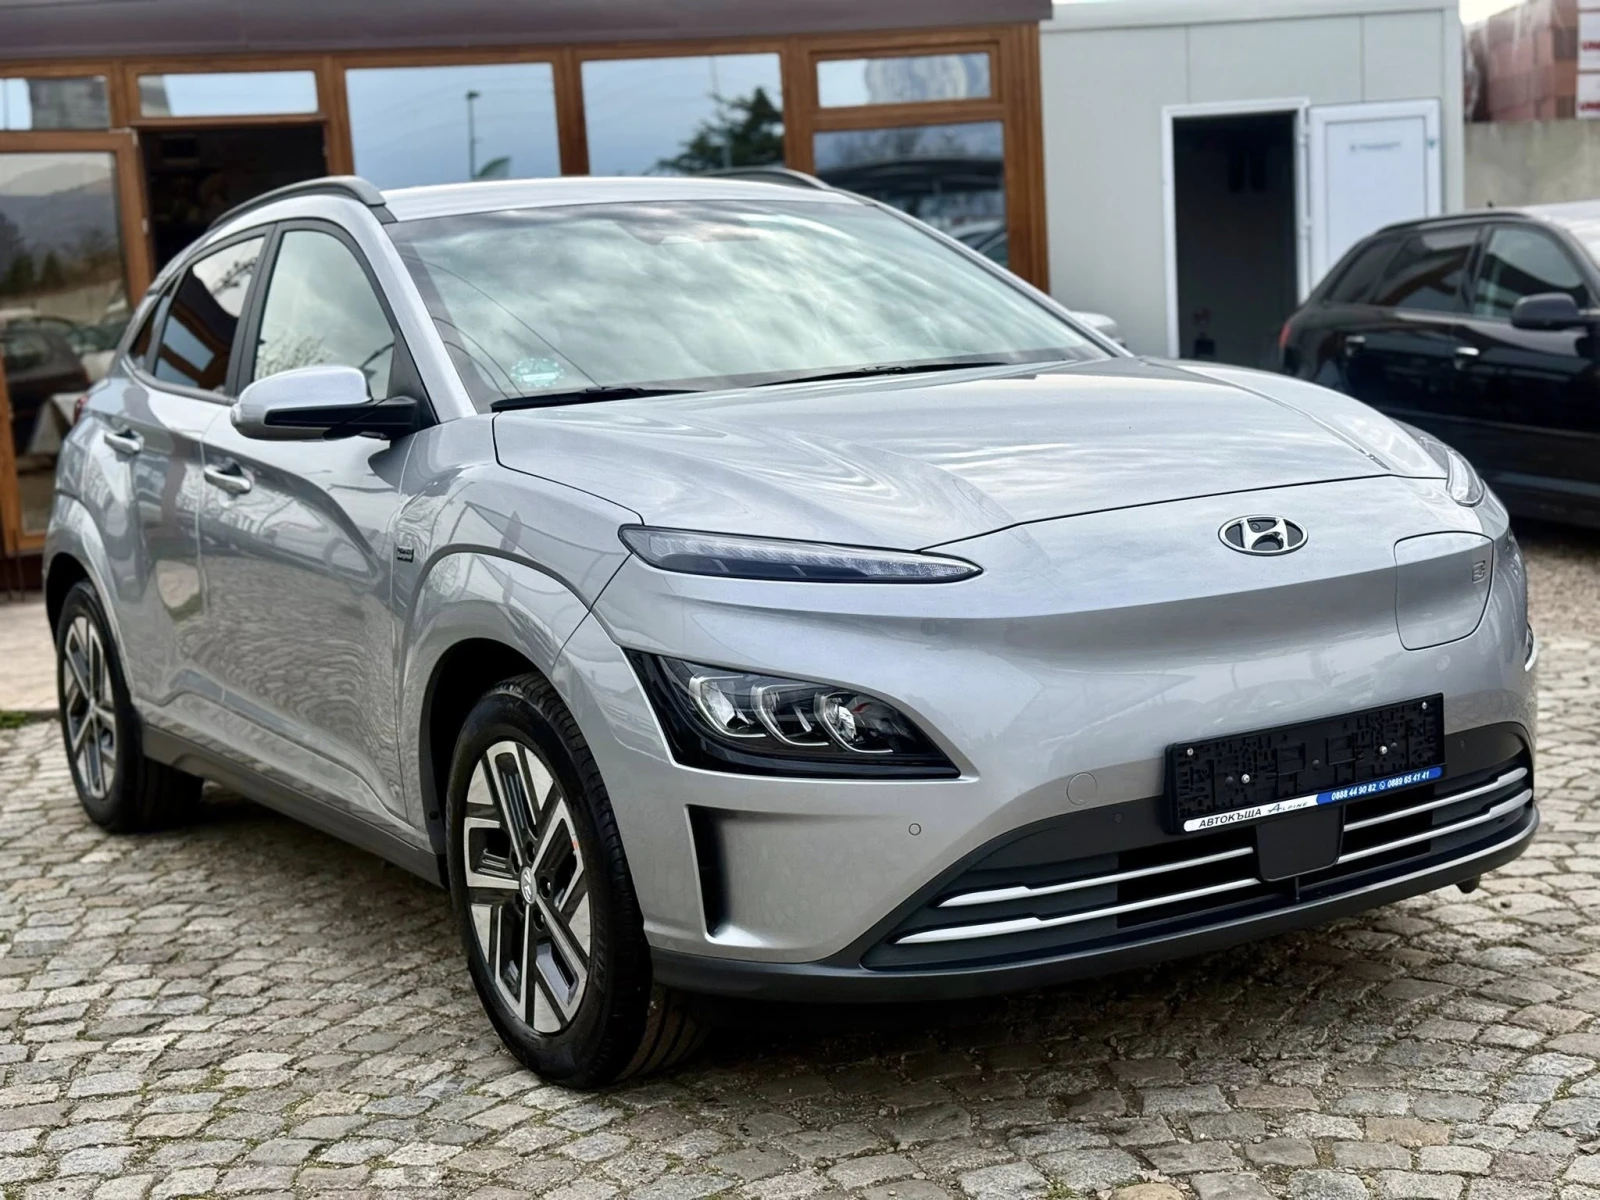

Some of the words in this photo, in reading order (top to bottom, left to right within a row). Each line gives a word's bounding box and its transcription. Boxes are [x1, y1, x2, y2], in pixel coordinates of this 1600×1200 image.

[1198, 808, 1262, 828] АВТОКЪША
[1331, 790, 1348, 801] 0888
[1349, 788, 1358, 796] 44
[1358, 785, 1367, 794] 90
[1367, 783, 1376, 792] 82
[1403, 774, 1412, 784] 65
[1413, 772, 1421, 782] 41
[1421, 770, 1430, 780] 41
